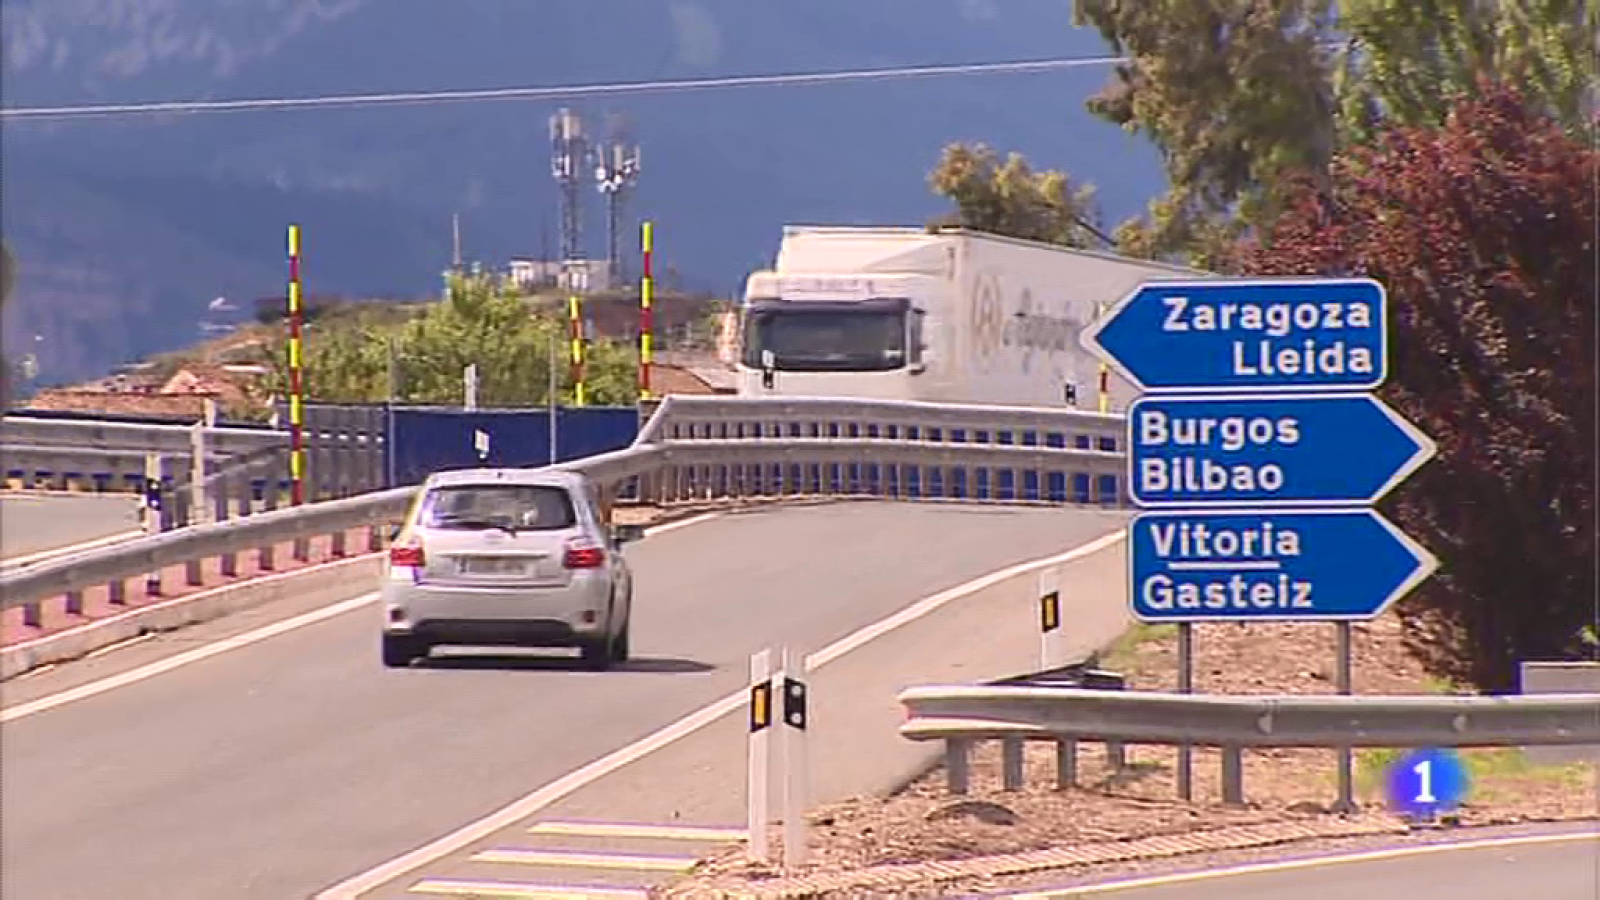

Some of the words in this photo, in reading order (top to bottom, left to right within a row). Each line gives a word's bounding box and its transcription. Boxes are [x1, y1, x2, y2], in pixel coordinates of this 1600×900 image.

[1163, 297, 1371, 337] Zaragoza
[1234, 340, 1372, 375] Lleida
[1140, 411, 1299, 450] Burgos
[1140, 458, 1283, 492] Bilbao
[1150, 523, 1300, 556] Vitoria
[1143, 575, 1313, 609] Gasteiz
